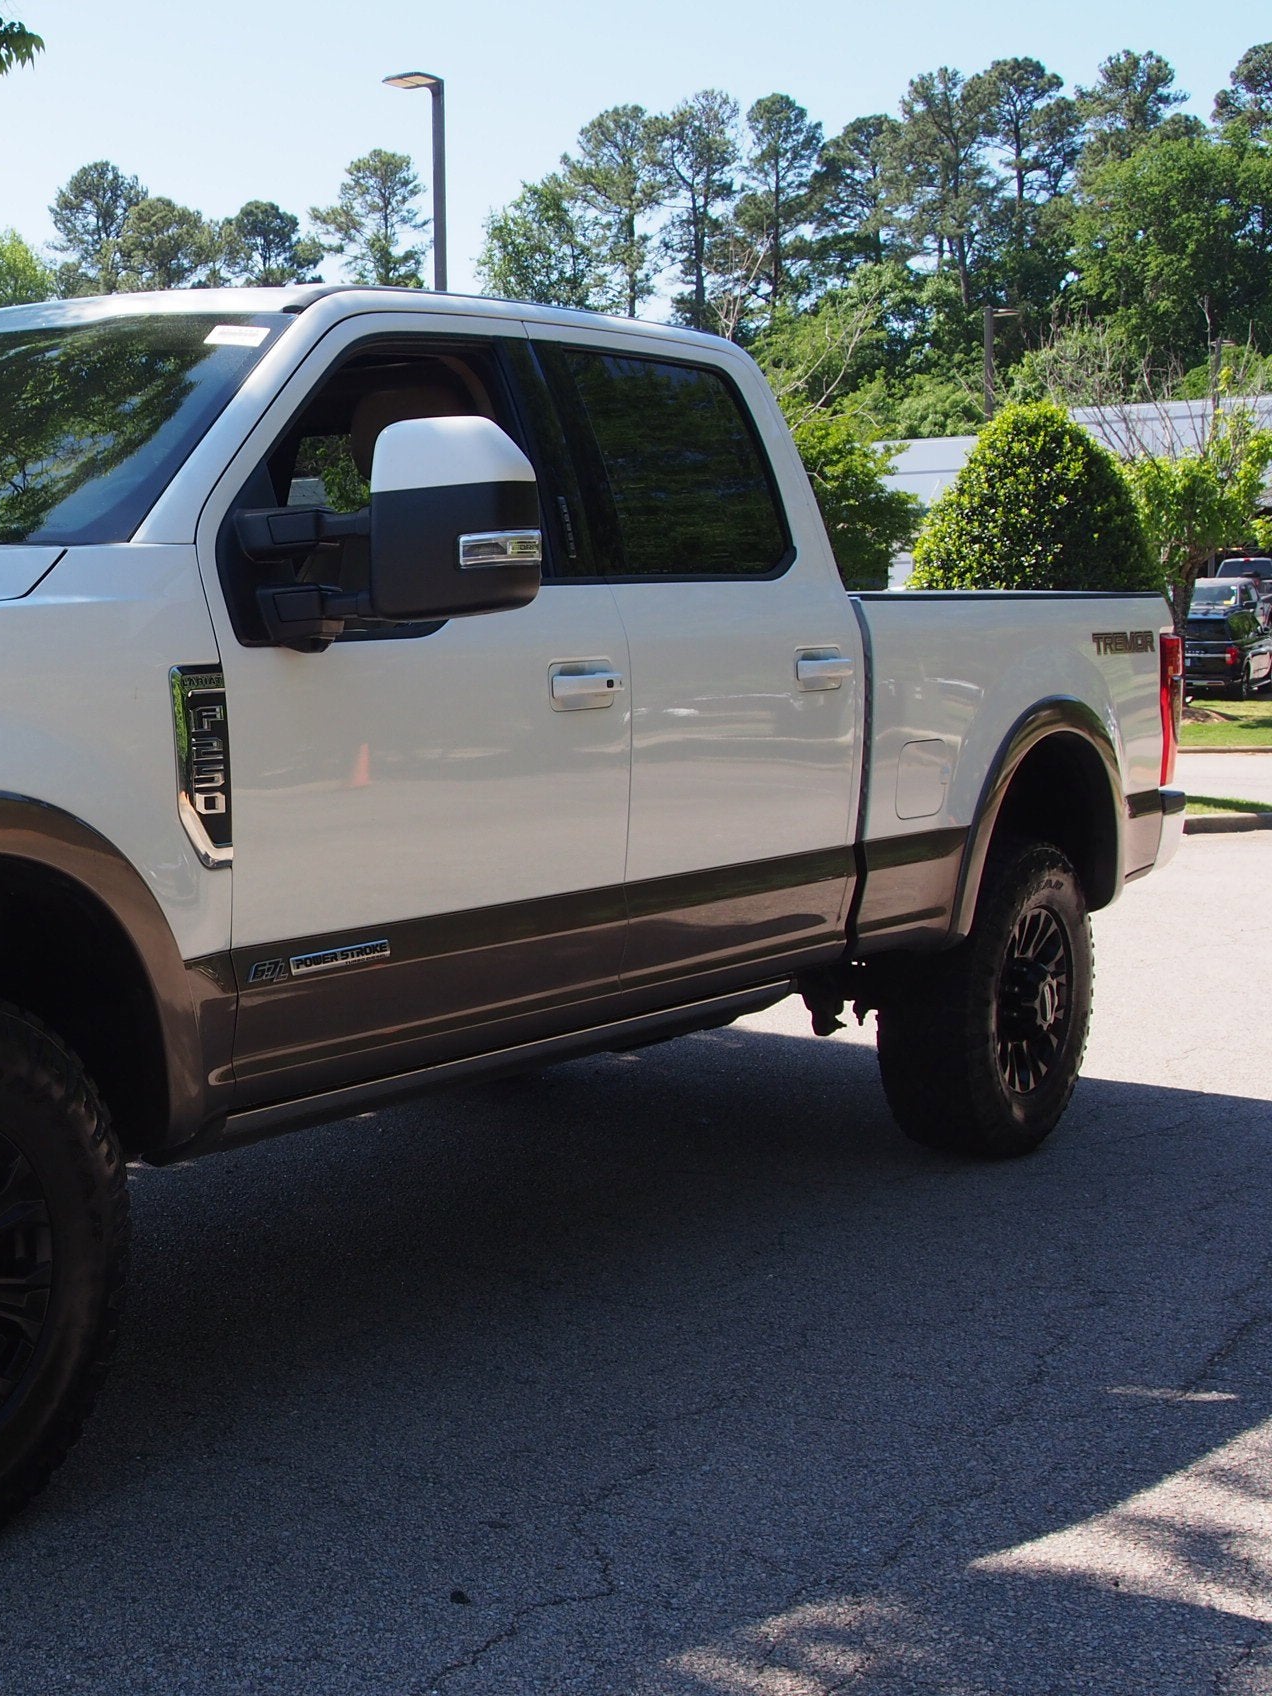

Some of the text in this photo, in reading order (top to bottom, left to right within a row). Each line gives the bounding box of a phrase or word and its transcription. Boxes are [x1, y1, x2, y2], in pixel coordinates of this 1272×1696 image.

[1091, 631, 1155, 655] TREMOR
[182, 675, 223, 687] LARIAT
[294, 943, 388, 969] POWER STROKE
